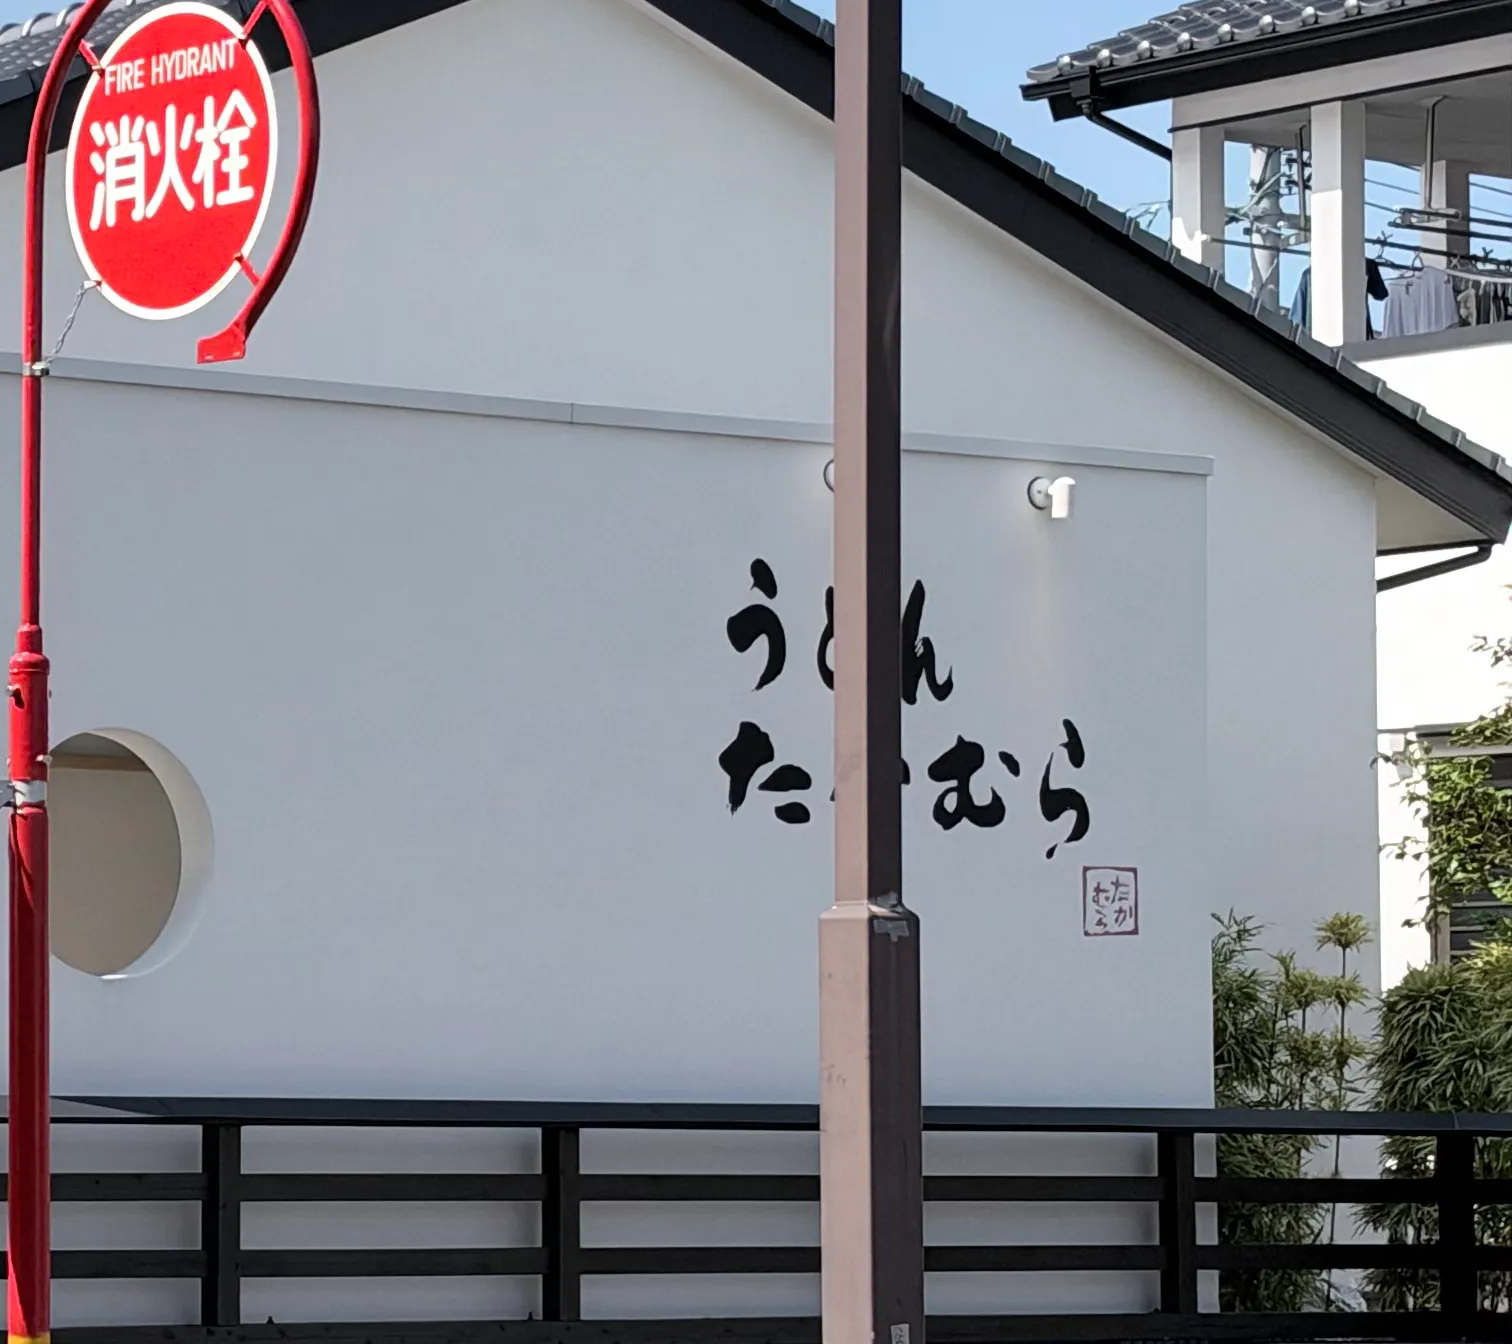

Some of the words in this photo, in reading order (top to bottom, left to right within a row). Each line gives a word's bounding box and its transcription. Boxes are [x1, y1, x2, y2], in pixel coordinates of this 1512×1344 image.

[105, 59, 145, 96] FIRE
[151, 38, 238, 86] HYDRANT
[89, 89, 257, 231] 消火栓
[727, 558, 954, 705] うん
[719, 719, 1090, 858] たむら
